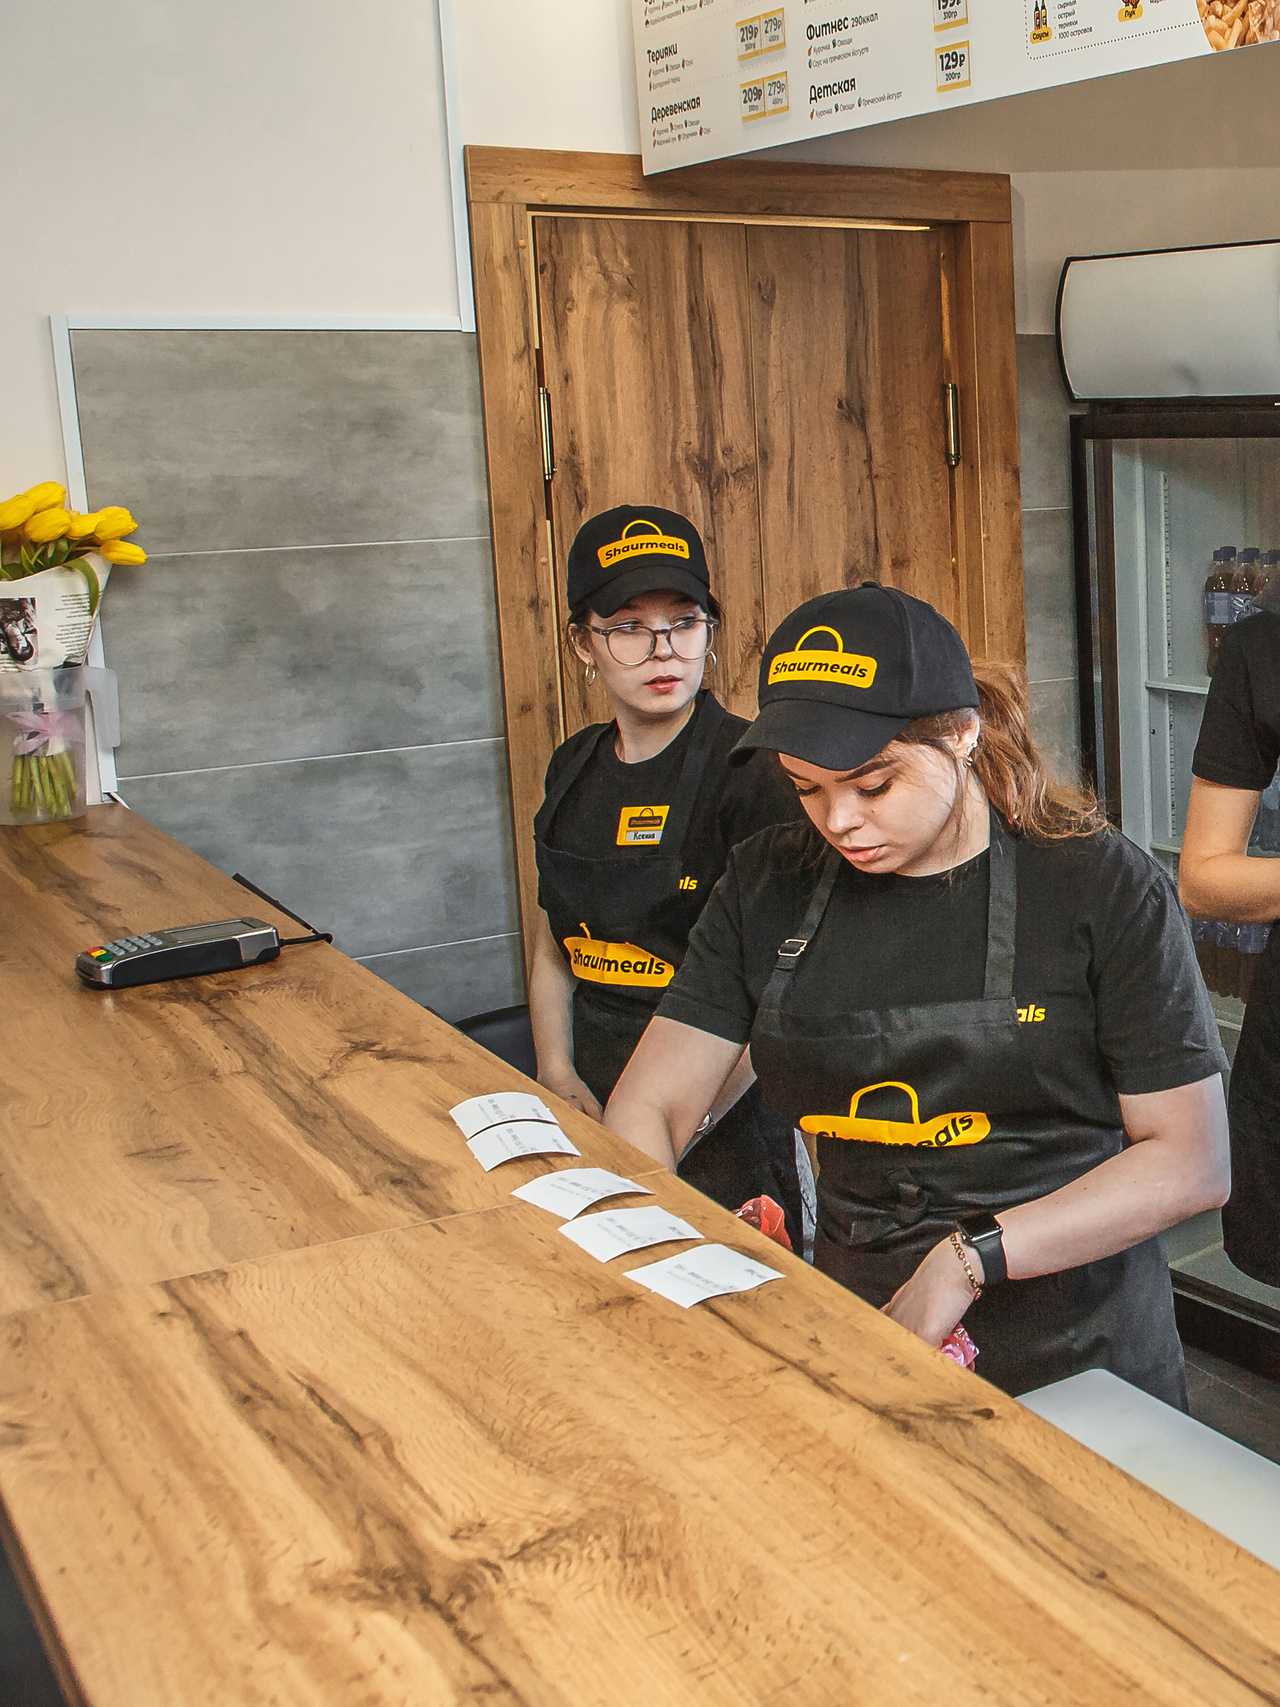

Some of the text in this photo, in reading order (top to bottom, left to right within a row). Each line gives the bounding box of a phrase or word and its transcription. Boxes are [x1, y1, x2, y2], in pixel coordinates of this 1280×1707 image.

[806, 12, 879, 41] Фитнес 290ккал
[1032, 30, 1050, 41] Соусы
[1058, 31, 1070, 39] 1000
[647, 43, 678, 65] Терияки
[809, 77, 856, 105] Детская
[651, 96, 702, 124] Деревенская
[605, 541, 685, 561] Shaurmeals
[772, 660, 868, 678] Shaurmeals
[573, 948, 666, 975] Shaurmeals
